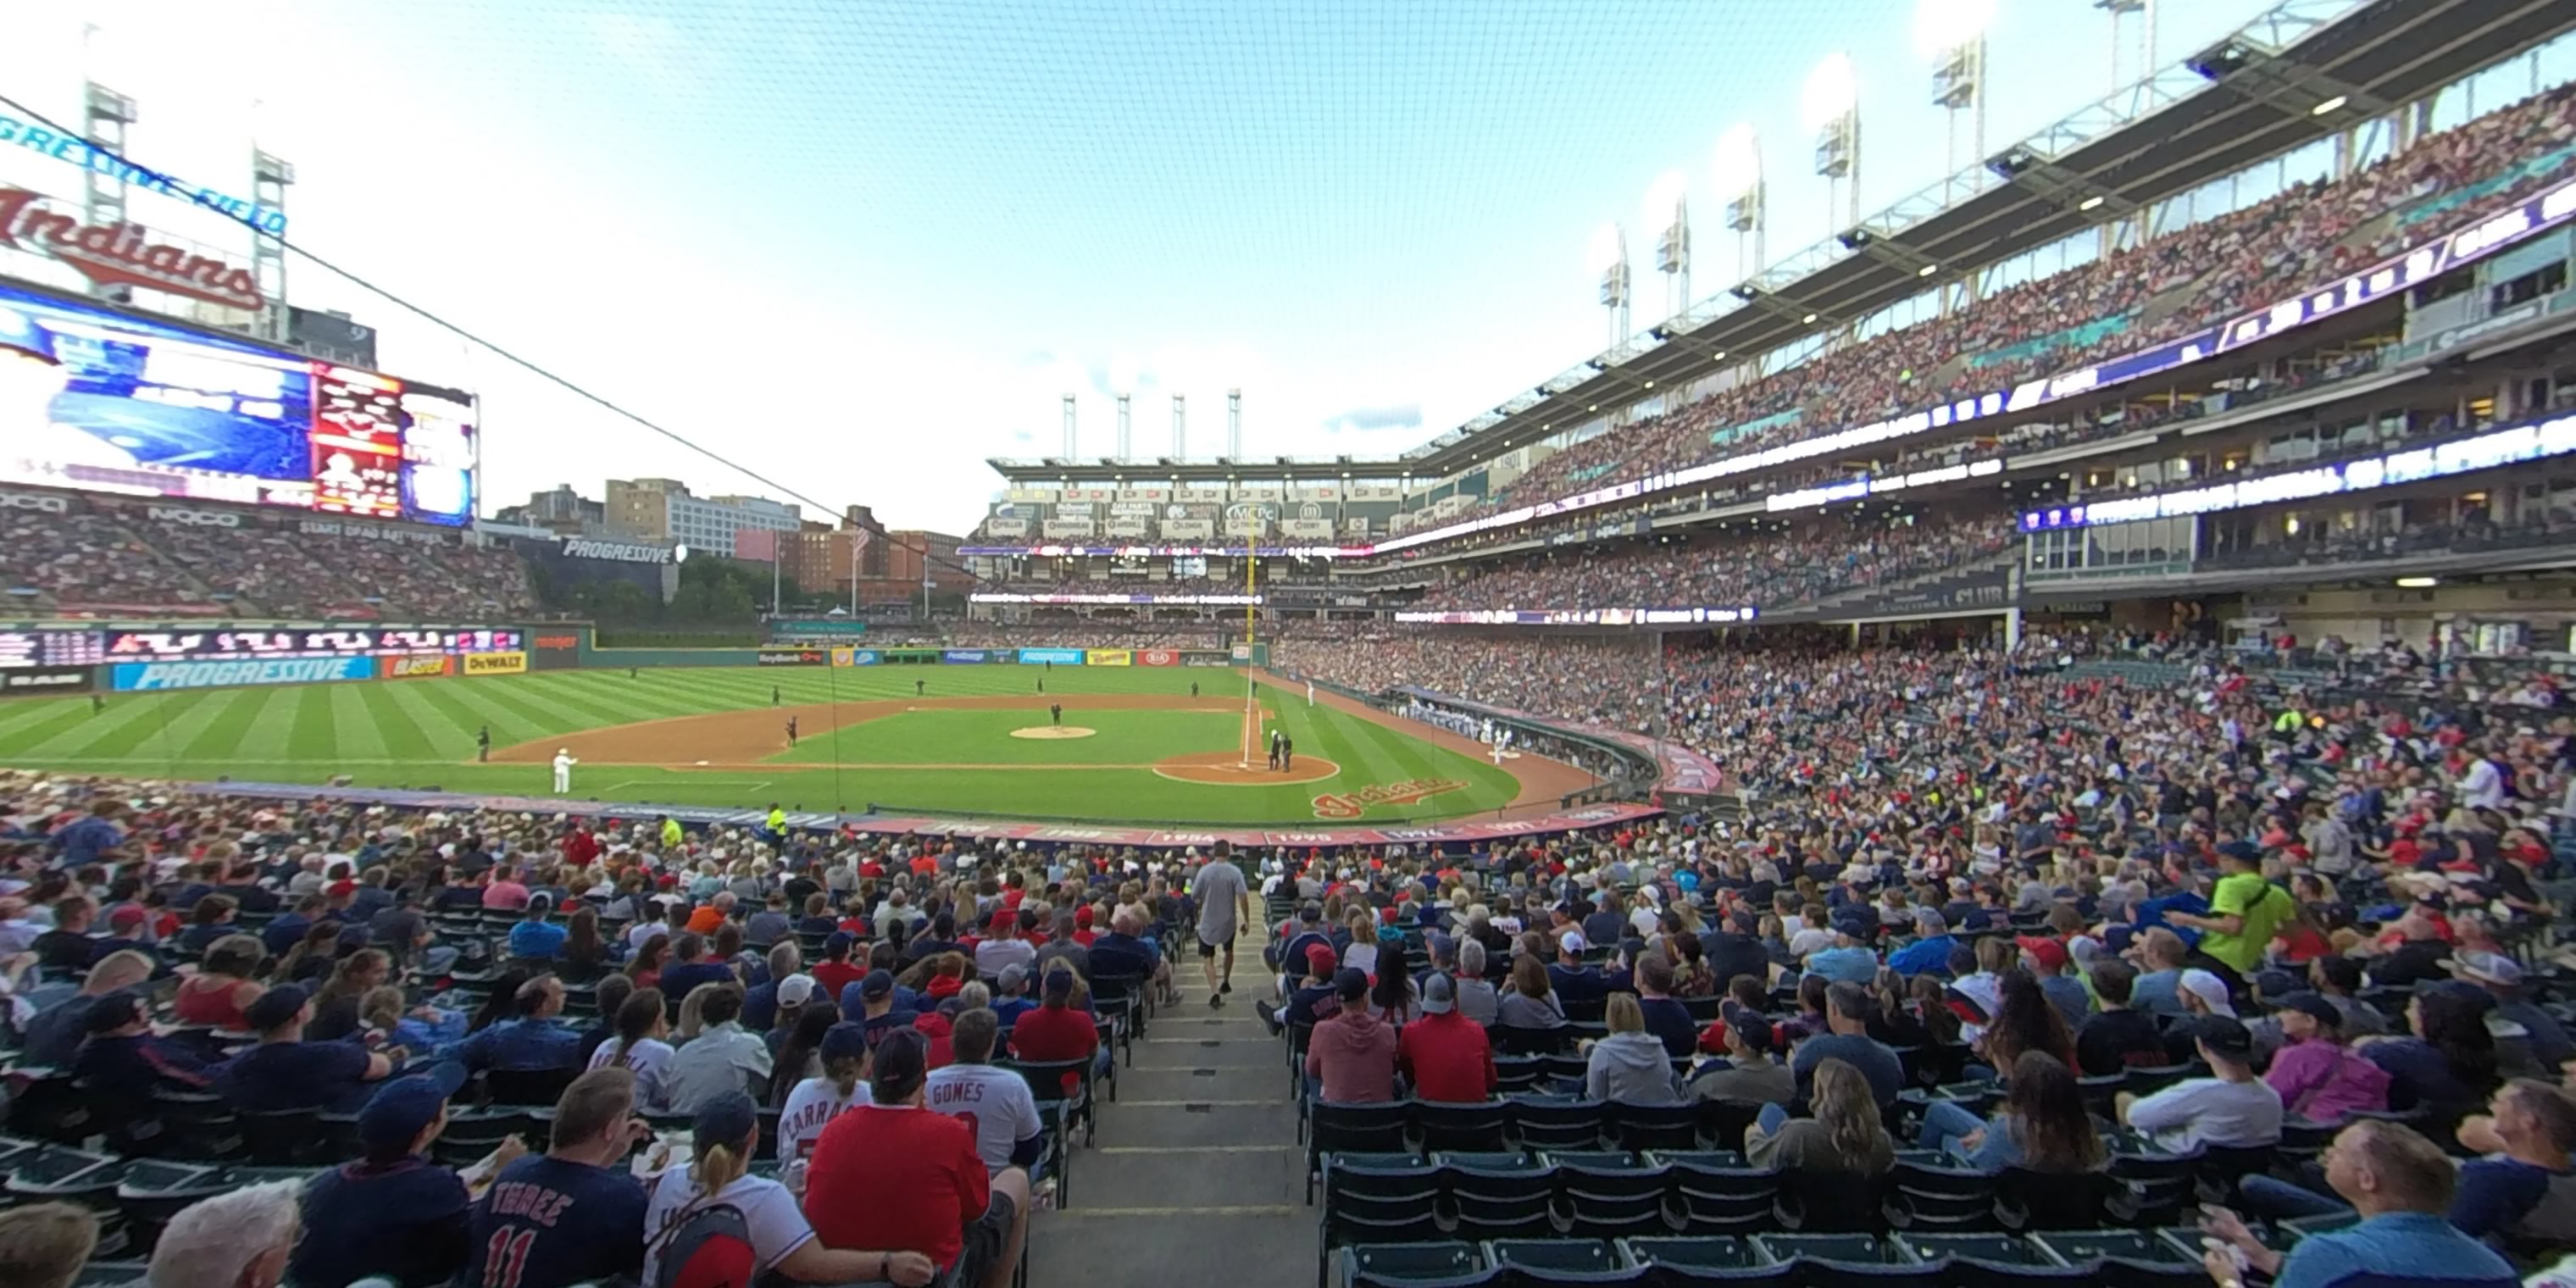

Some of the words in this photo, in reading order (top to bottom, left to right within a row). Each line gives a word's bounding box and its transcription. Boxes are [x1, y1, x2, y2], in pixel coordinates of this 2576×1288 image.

[563, 540, 672, 564] PROGRESSIVE
[135, 658, 351, 690] PROGRESSIVE
[1312, 779, 1470, 819] Indians
[933, 1083, 985, 1105] GOMES
[490, 1182, 575, 1228] THREE
[482, 1224, 537, 1288] 11
